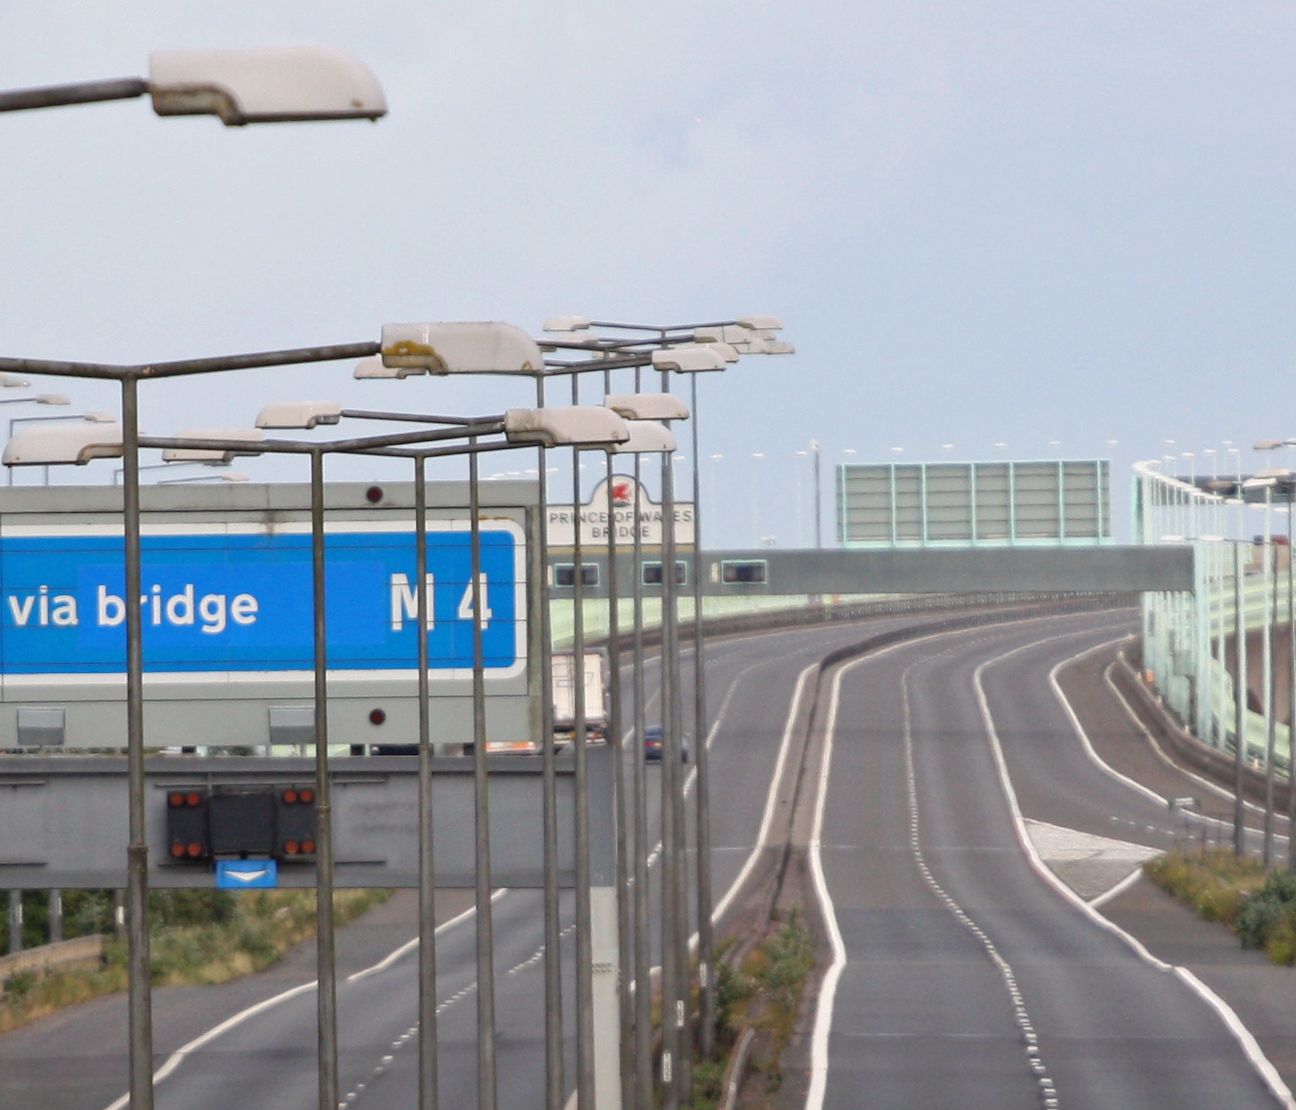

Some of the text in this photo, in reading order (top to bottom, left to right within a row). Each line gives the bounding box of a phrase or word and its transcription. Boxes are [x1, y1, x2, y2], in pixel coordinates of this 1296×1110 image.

[615, 511, 633, 522] OF
[638, 510, 692, 522] WAES
[592, 526, 650, 538] BRDE
[8, 584, 79, 626] via
